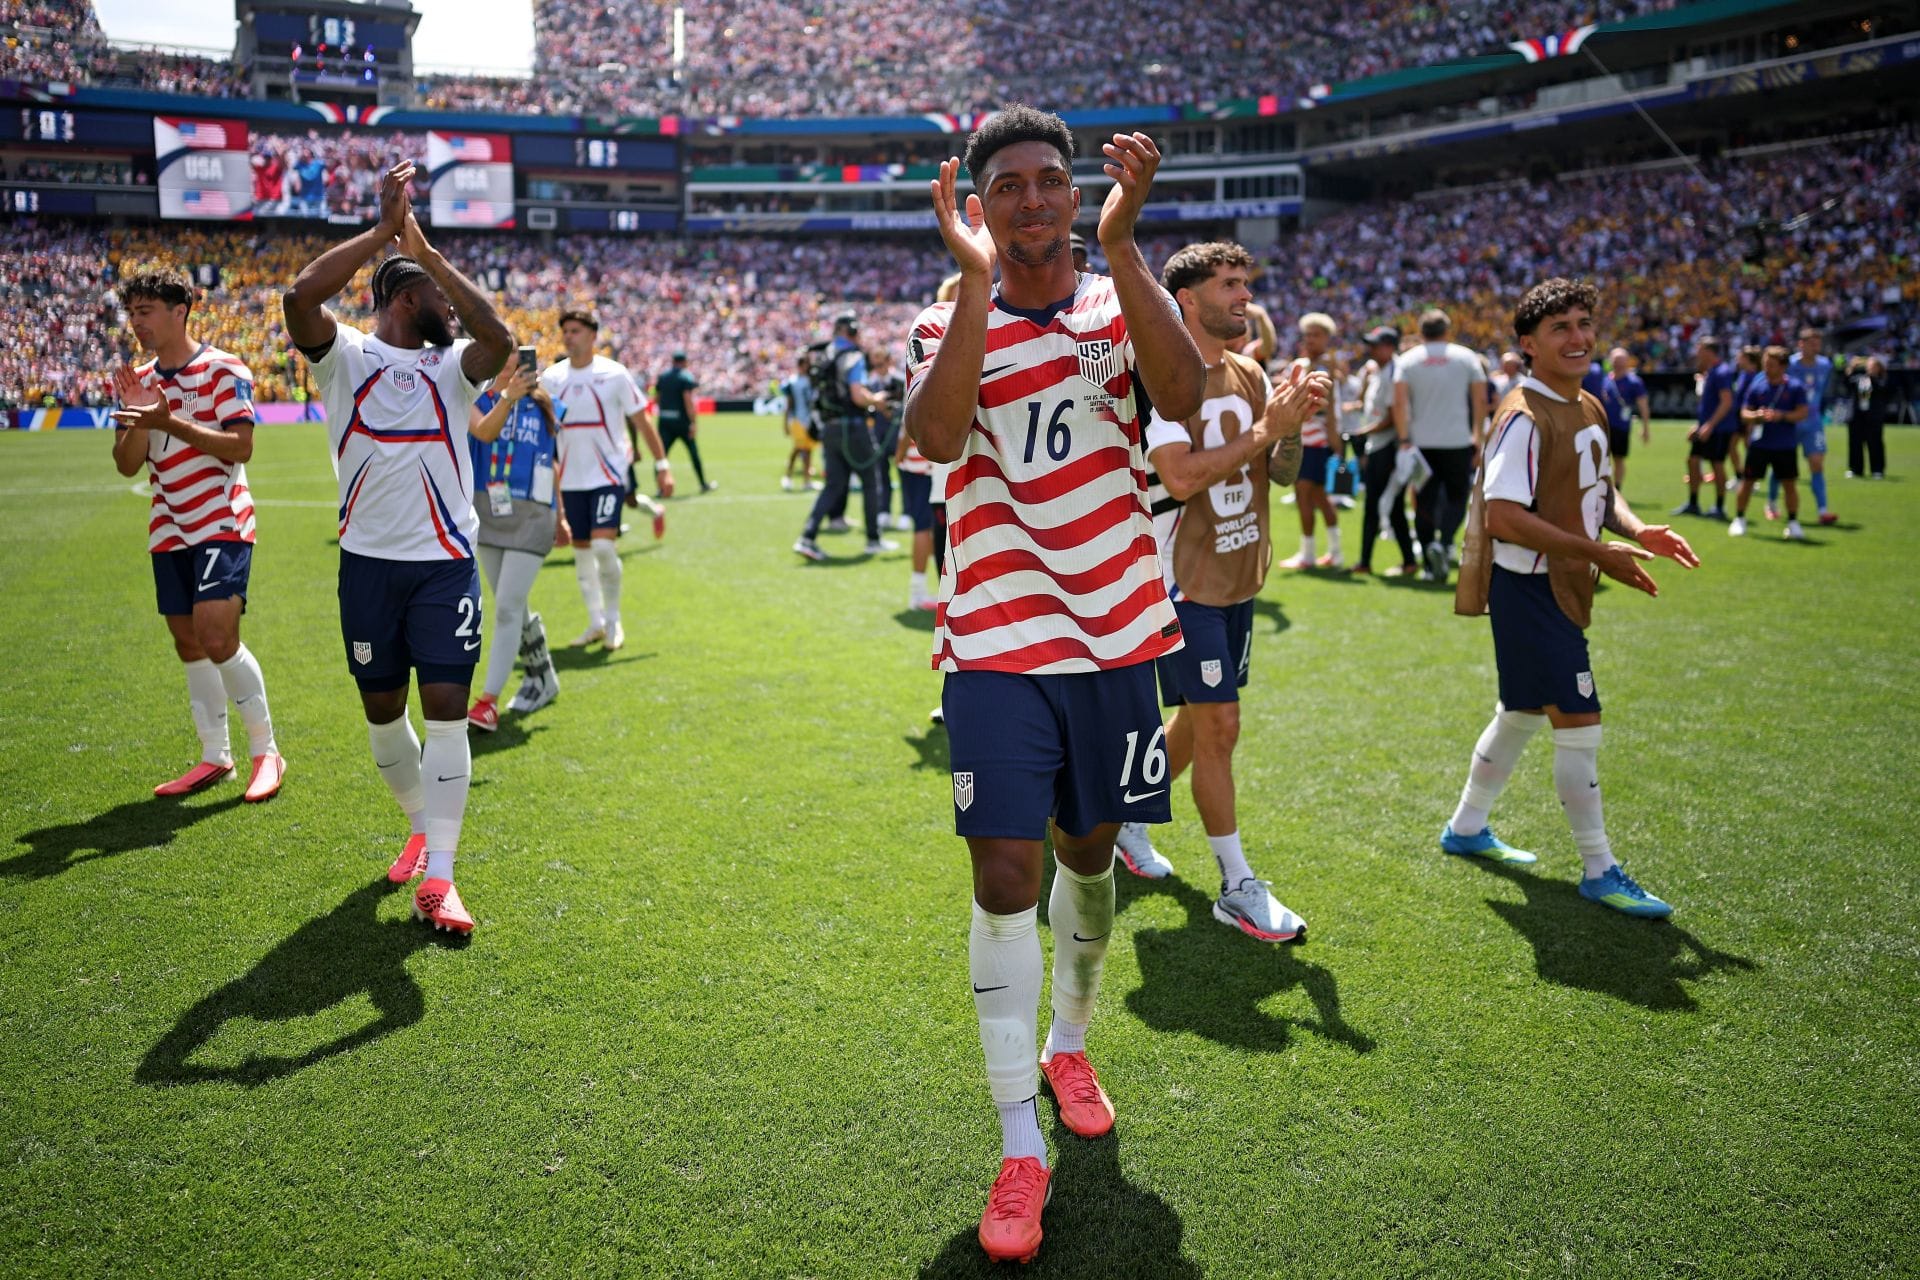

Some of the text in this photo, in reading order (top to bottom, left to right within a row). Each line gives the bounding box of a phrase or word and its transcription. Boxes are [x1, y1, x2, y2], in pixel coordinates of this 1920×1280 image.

[185, 156, 224, 182] USA
[455, 168, 489, 191] USA
[1079, 341, 1111, 360] USA
[395, 371, 413, 382] USA
[1023, 398, 1074, 464] 16
[597, 493, 616, 514] 18
[1224, 490, 1245, 505] FIF
[202, 547, 221, 580] 7
[1202, 661, 1220, 673] USA
[1119, 725, 1167, 787] 16
[954, 773, 972, 789] USA
